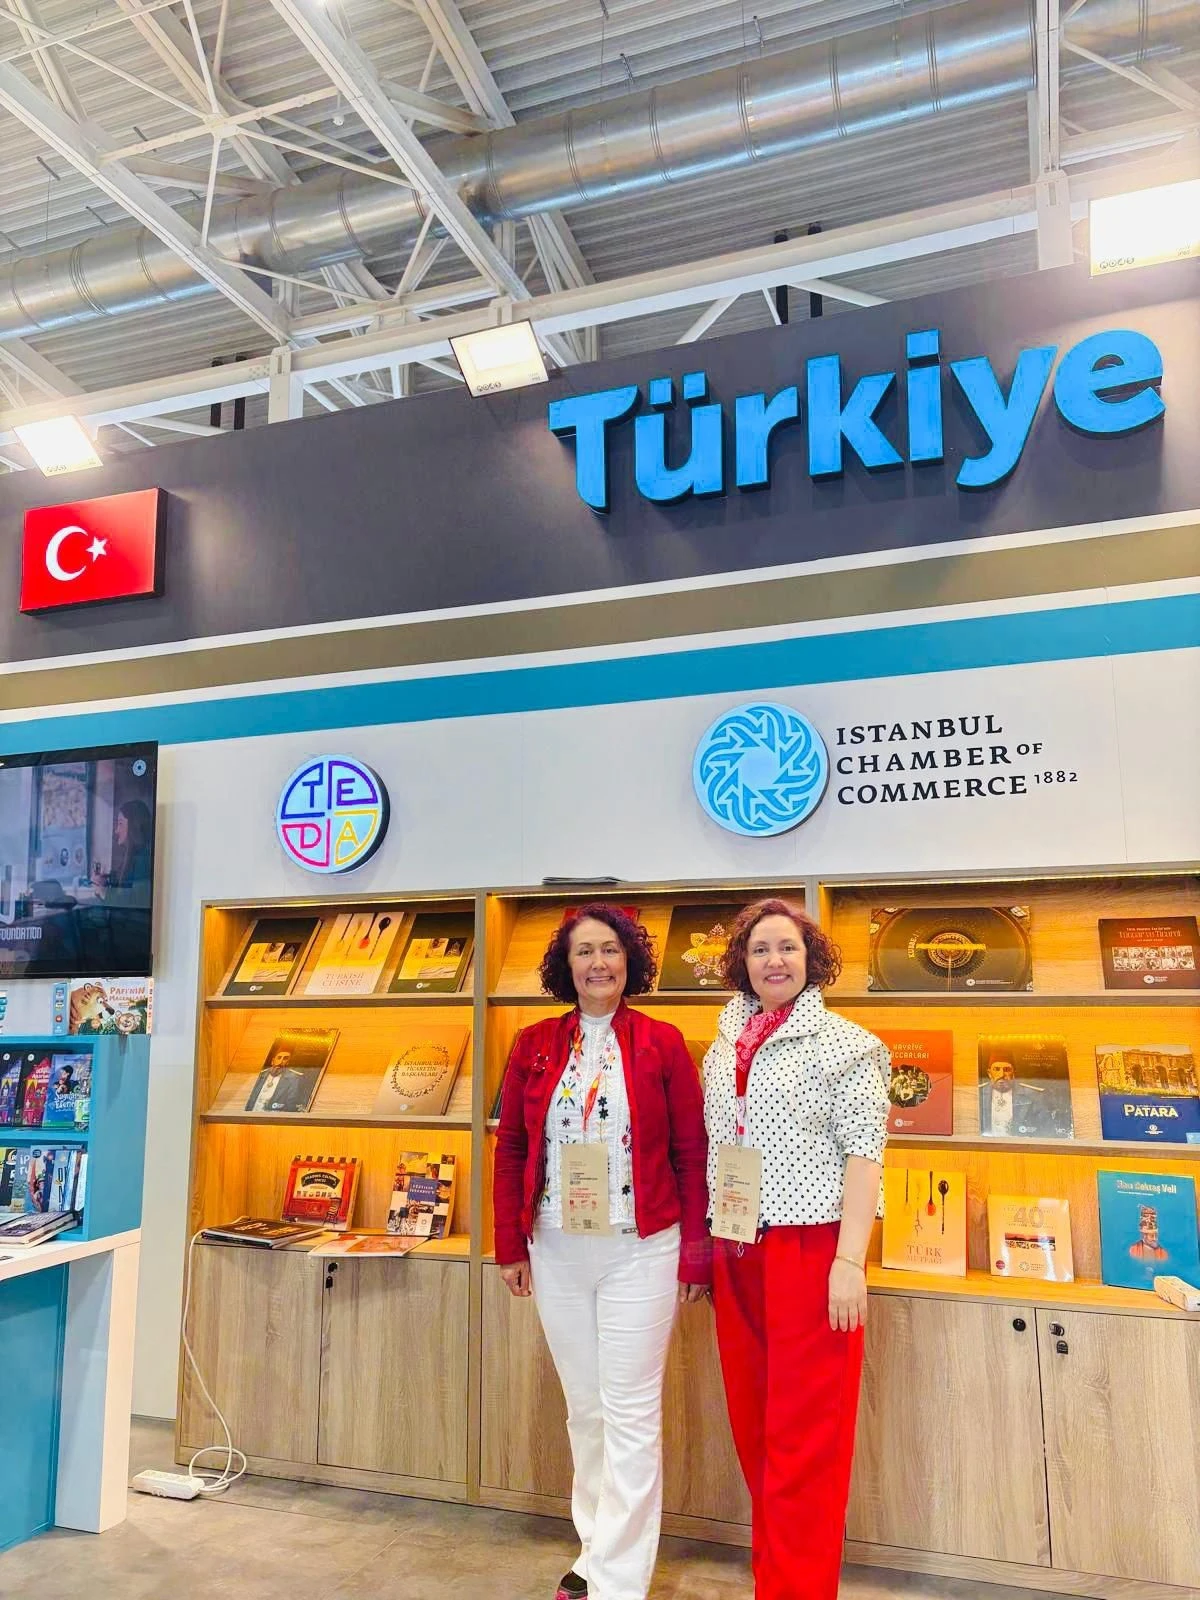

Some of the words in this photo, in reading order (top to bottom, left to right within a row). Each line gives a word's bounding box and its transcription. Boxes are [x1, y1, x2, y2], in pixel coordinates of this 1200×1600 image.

[548, 329, 1167, 513] Türkiye
[836, 714, 1003, 746] ISTANBUL
[836, 745, 1012, 775] CHAMBER
[1016, 742, 1043, 756] OF
[837, 775, 1028, 805] COMMERCE
[1034, 770, 1079, 784] 1882
[1123, 1103, 1179, 1118] PATARA
[1161, 1183, 1177, 1194] Veli
